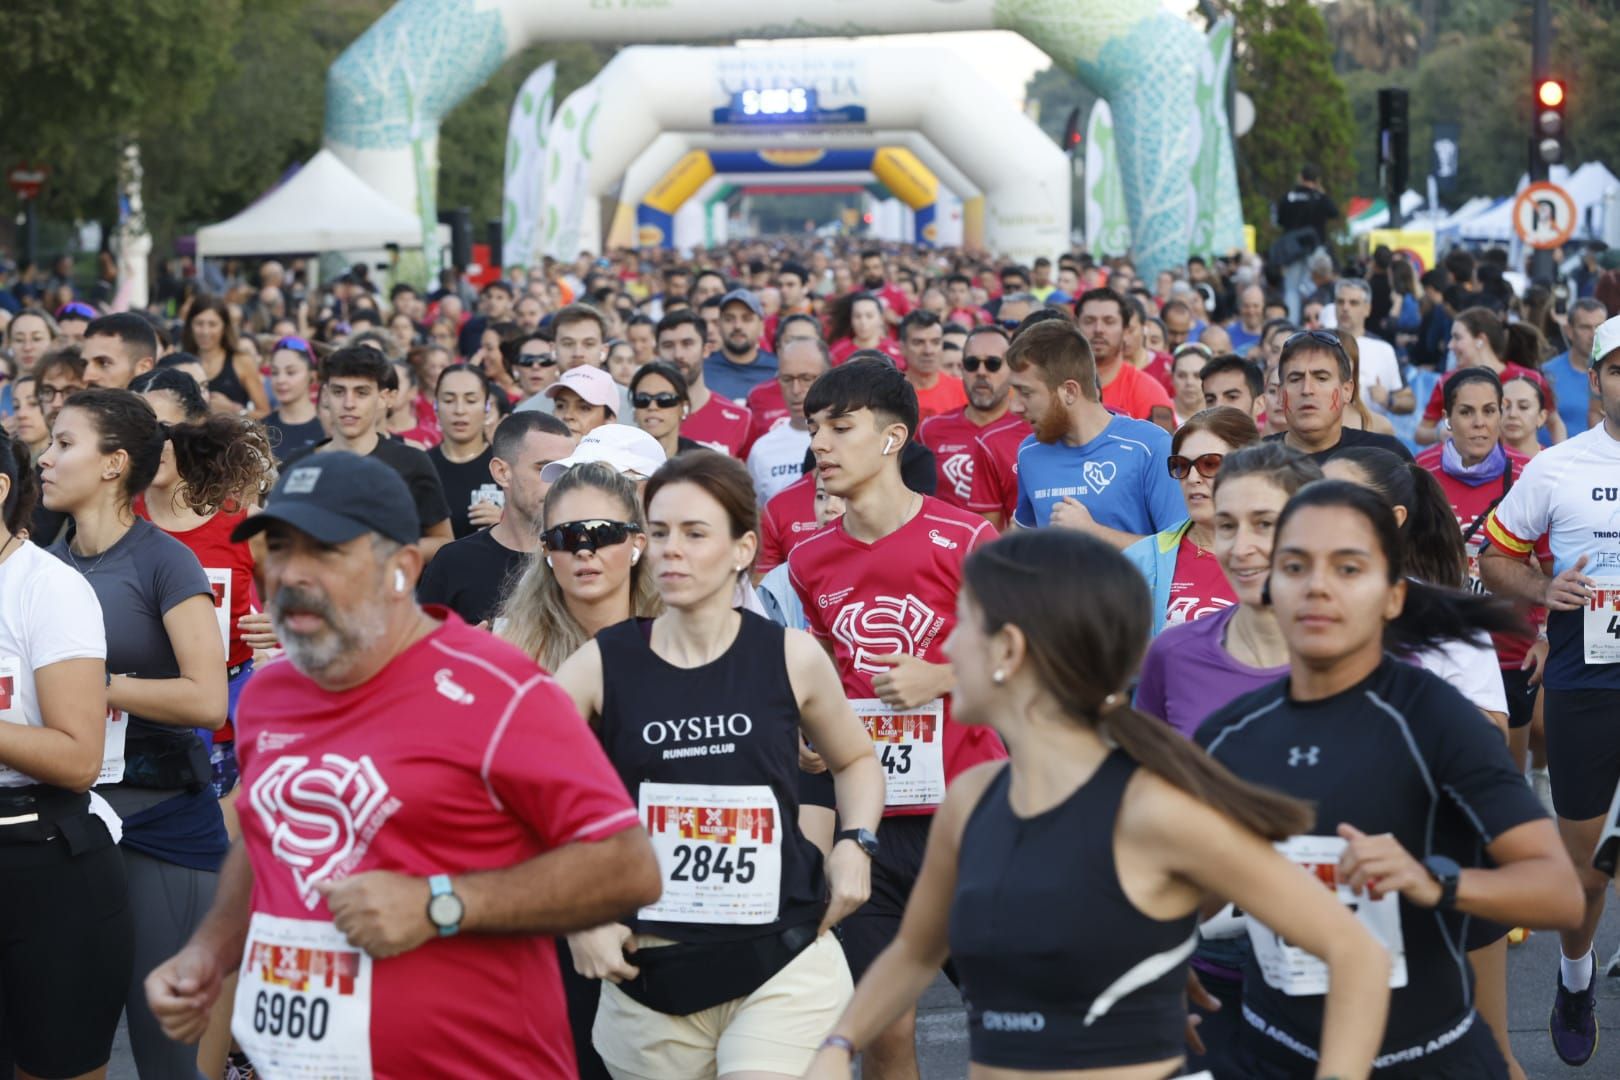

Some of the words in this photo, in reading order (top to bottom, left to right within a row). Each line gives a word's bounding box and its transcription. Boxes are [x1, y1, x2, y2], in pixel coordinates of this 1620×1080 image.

[771, 463, 806, 477] CUM
[642, 712, 753, 745] OYSHO
[662, 745, 708, 761] RUNNING
[708, 742, 736, 755] CLUB
[880, 744, 913, 775] 43
[670, 844, 758, 884] 2845
[253, 990, 330, 1042] 6960
